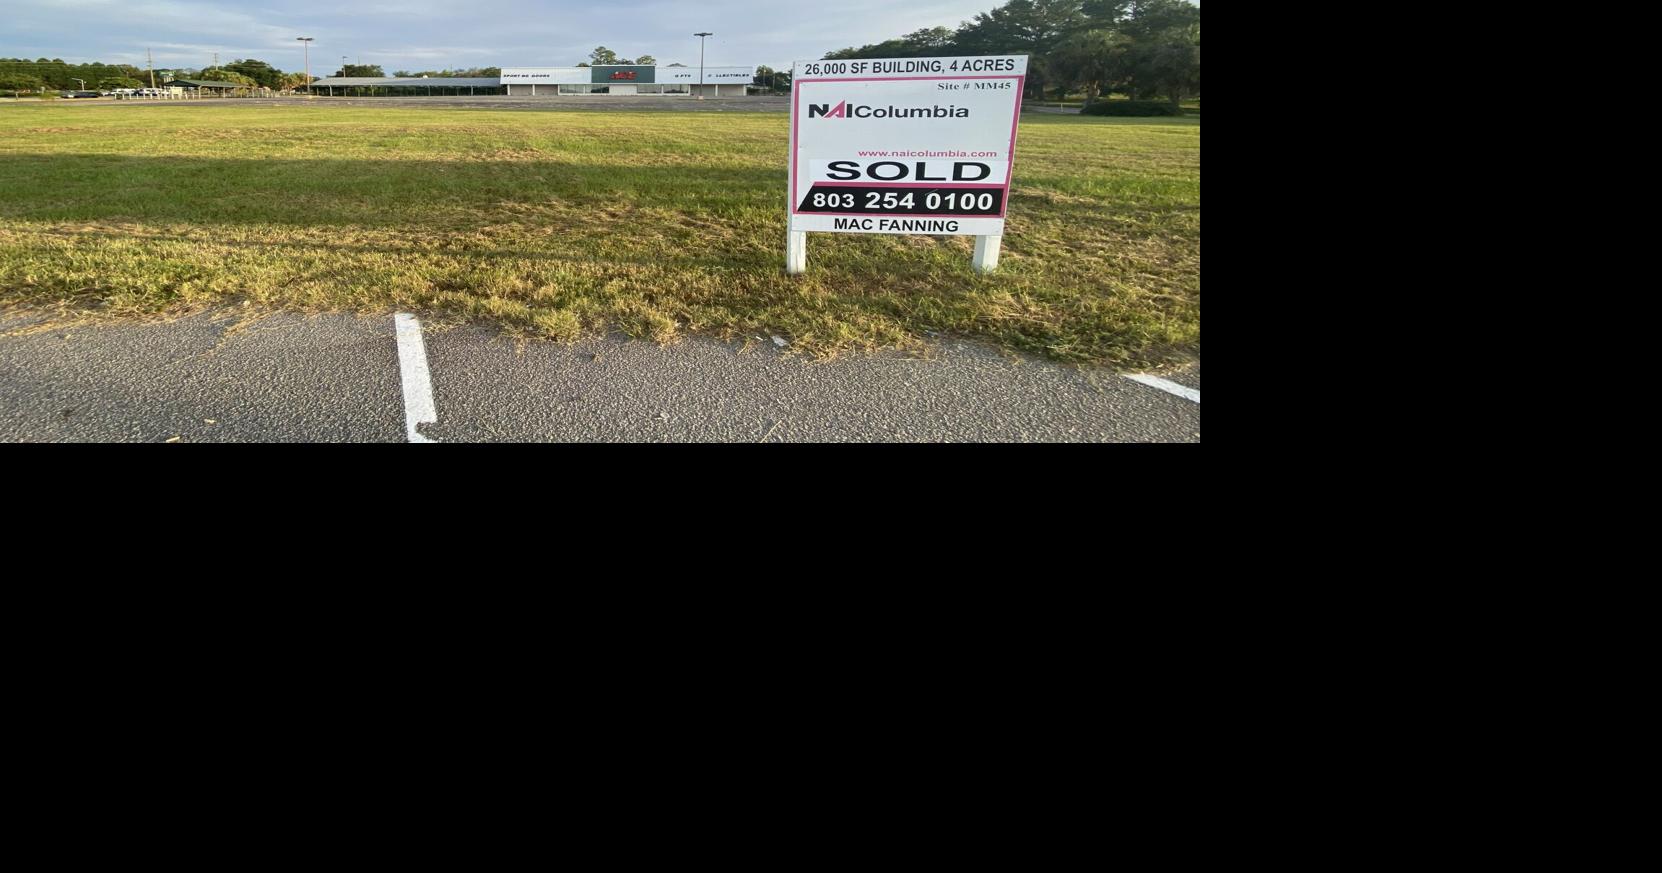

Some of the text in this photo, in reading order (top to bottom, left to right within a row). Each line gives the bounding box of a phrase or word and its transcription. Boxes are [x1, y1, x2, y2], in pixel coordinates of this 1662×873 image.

[804, 58, 1015, 76] 26,000 SF BUILDING, 4 ACRES
[937, 81, 1012, 90] Site # MM45
[858, 150, 998, 158] www.naicolumbia.com
[826, 160, 991, 182] SOLD
[813, 192, 993, 210] 803 254 0100
[833, 218, 959, 232] MAC FANNING
